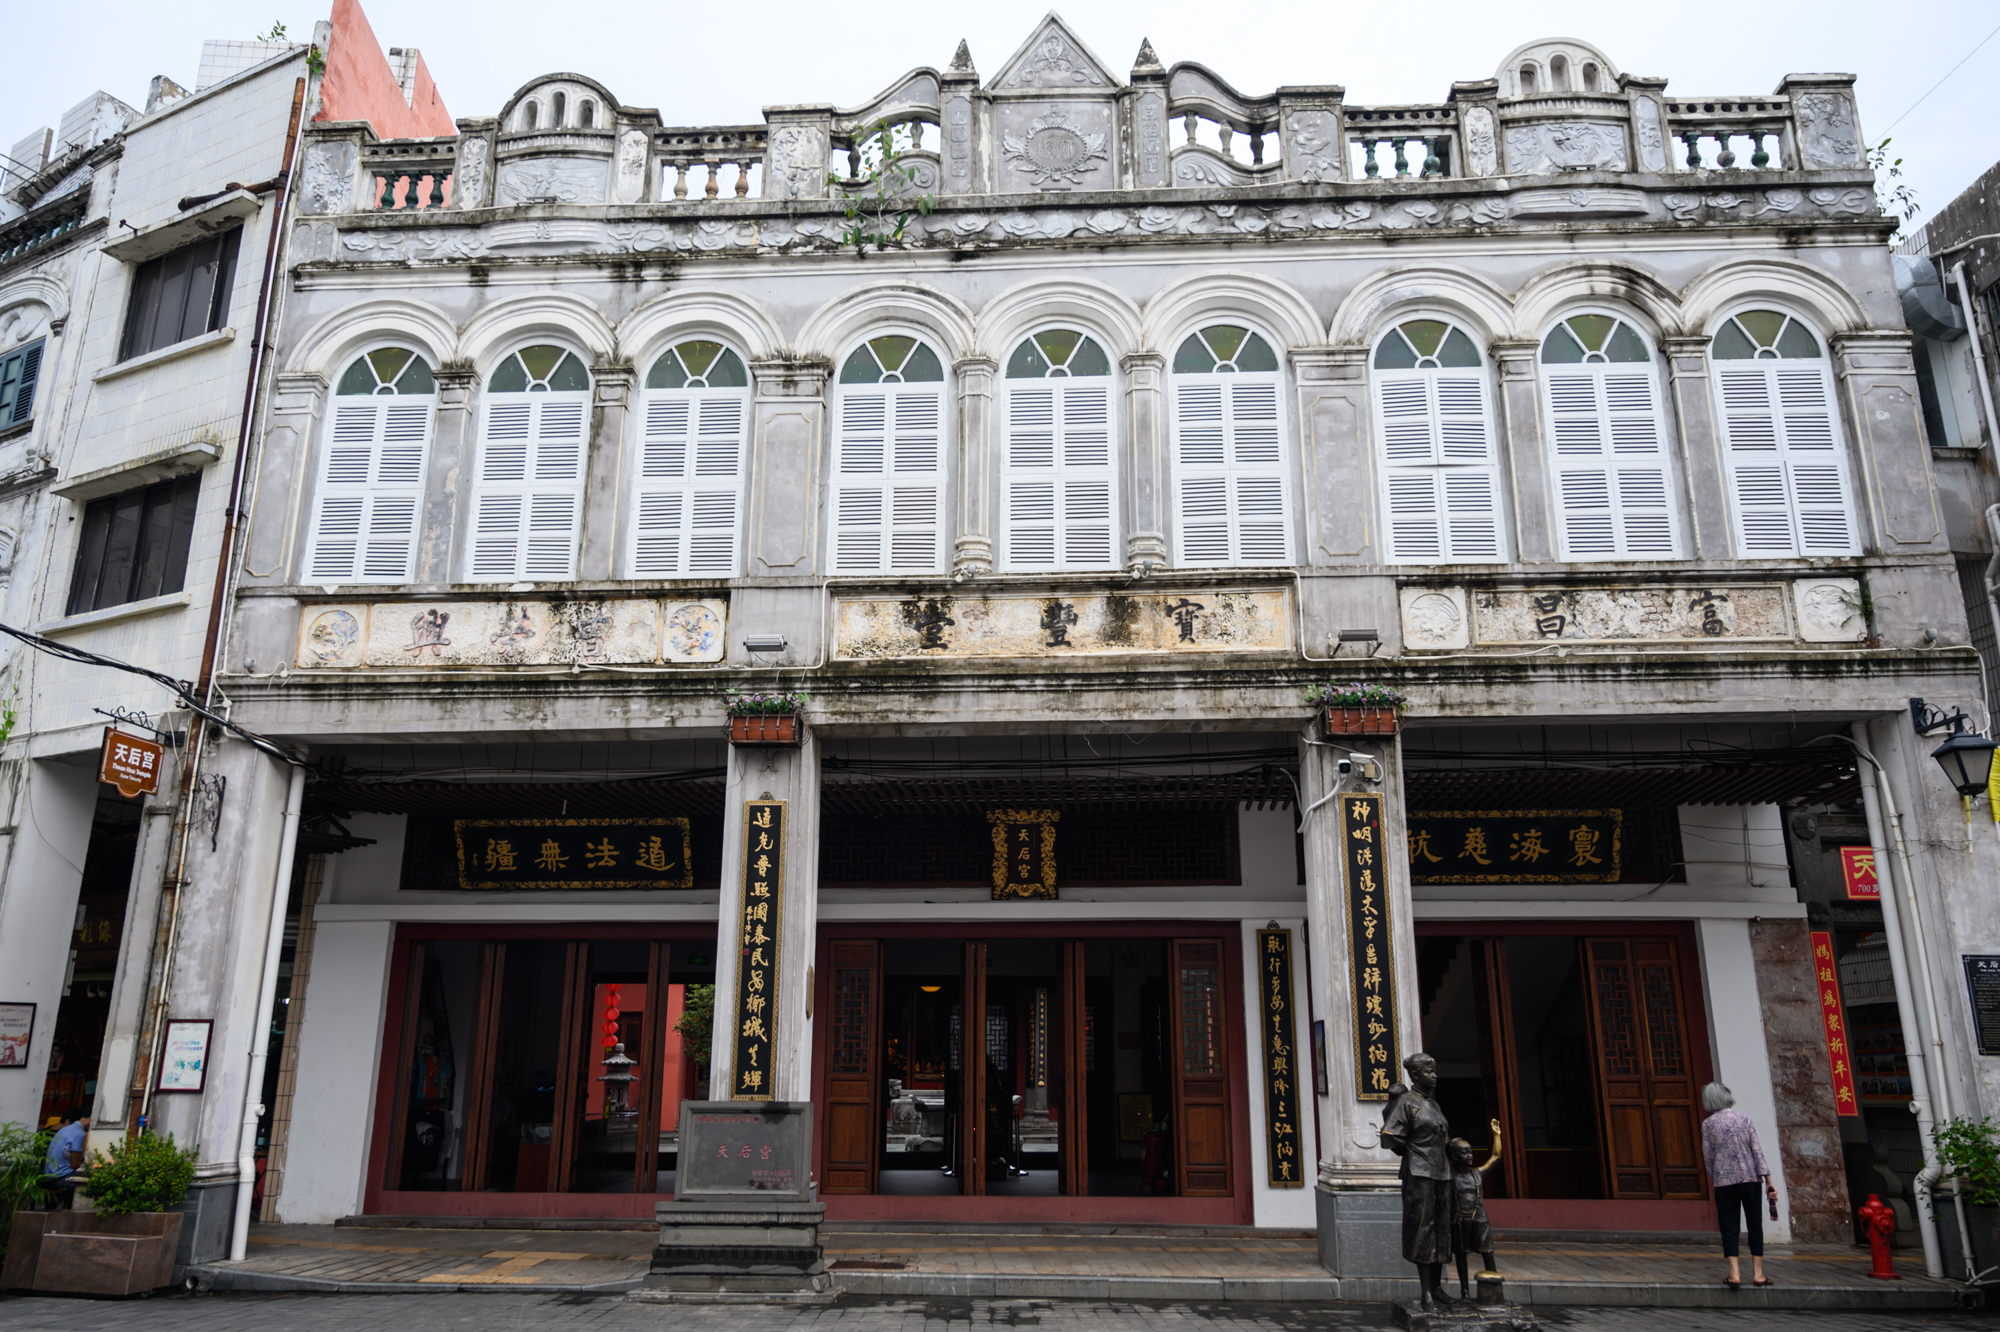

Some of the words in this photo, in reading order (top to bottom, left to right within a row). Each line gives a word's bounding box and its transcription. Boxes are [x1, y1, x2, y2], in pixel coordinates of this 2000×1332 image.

[114, 743, 155, 770] 天后宫
[484, 835, 676, 872] 道法無疆
[1852, 854, 1877, 880] 天
[1857, 884, 1871, 893] 700
[716, 1144, 772, 1160] 天后宫
